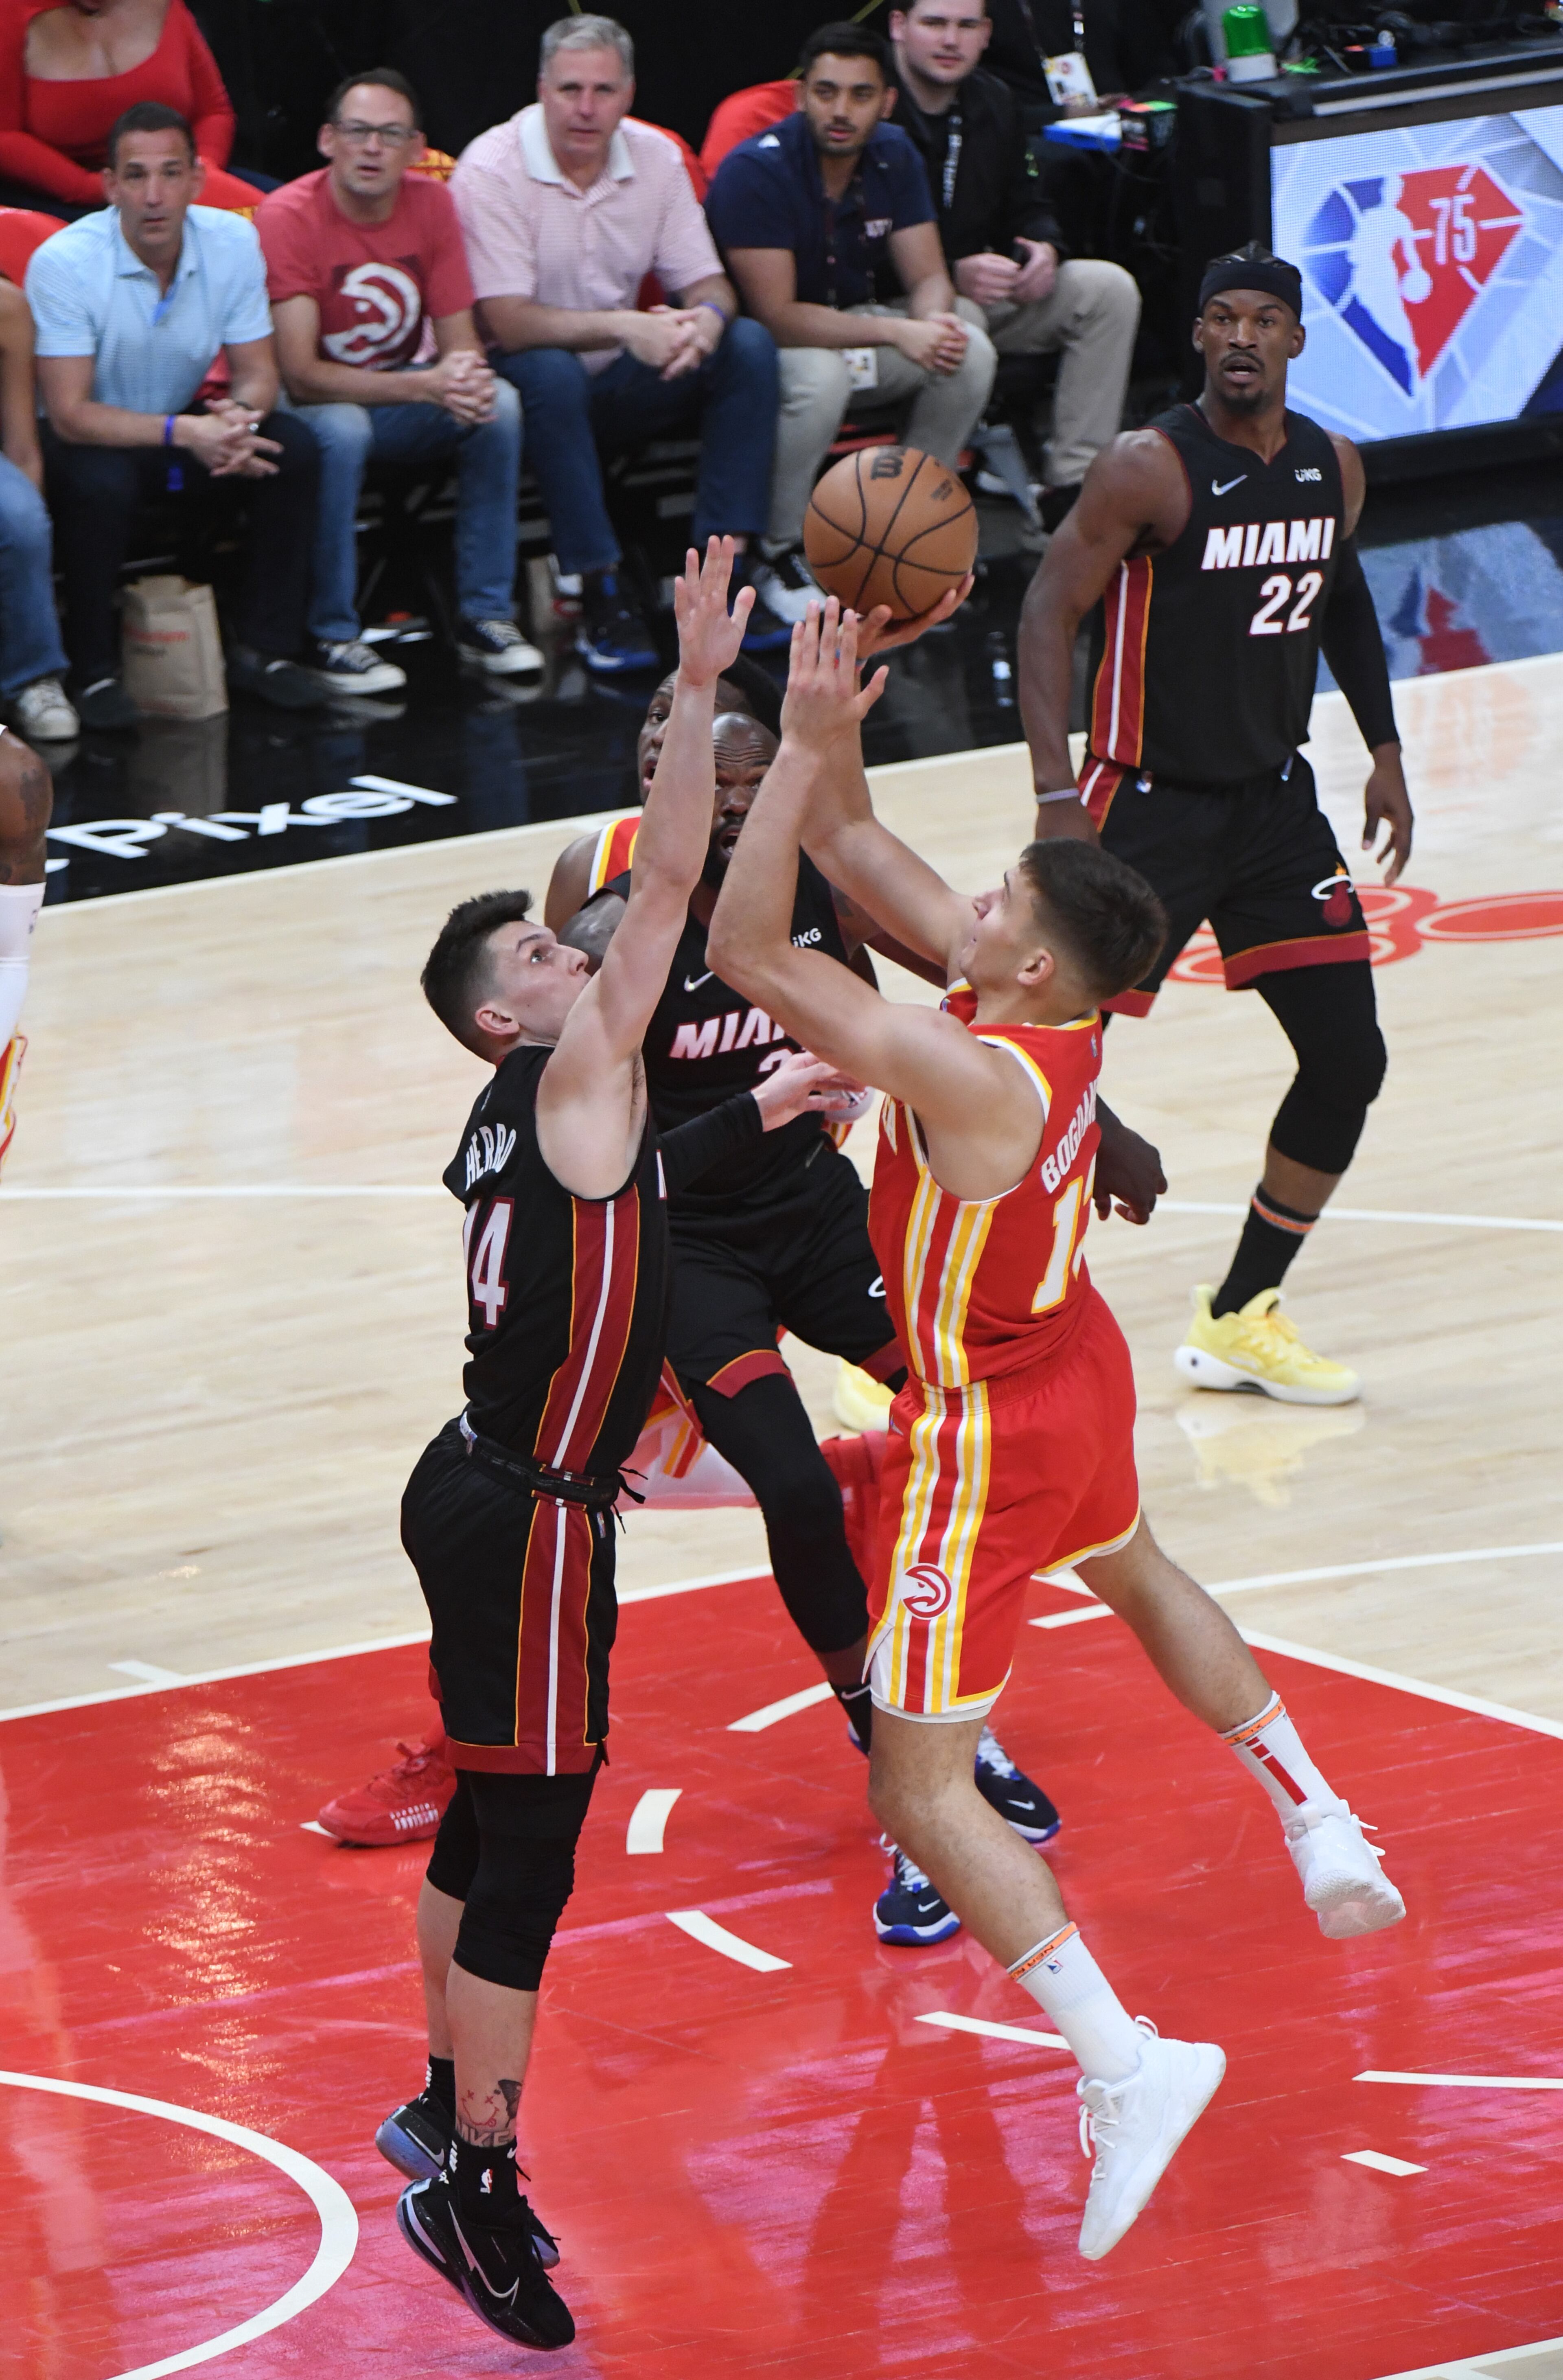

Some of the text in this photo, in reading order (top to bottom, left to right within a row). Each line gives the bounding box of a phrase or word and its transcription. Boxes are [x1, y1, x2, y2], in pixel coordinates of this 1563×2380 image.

[1429, 193, 1475, 265] 75
[1200, 516, 1336, 570] MIAMI
[1248, 570, 1324, 636] 22
[45, 774, 458, 859] Pixel
[668, 1006, 786, 1059] MIA
[465, 1123, 516, 1191] HERRO
[1031, 1151, 1097, 1314] 1
